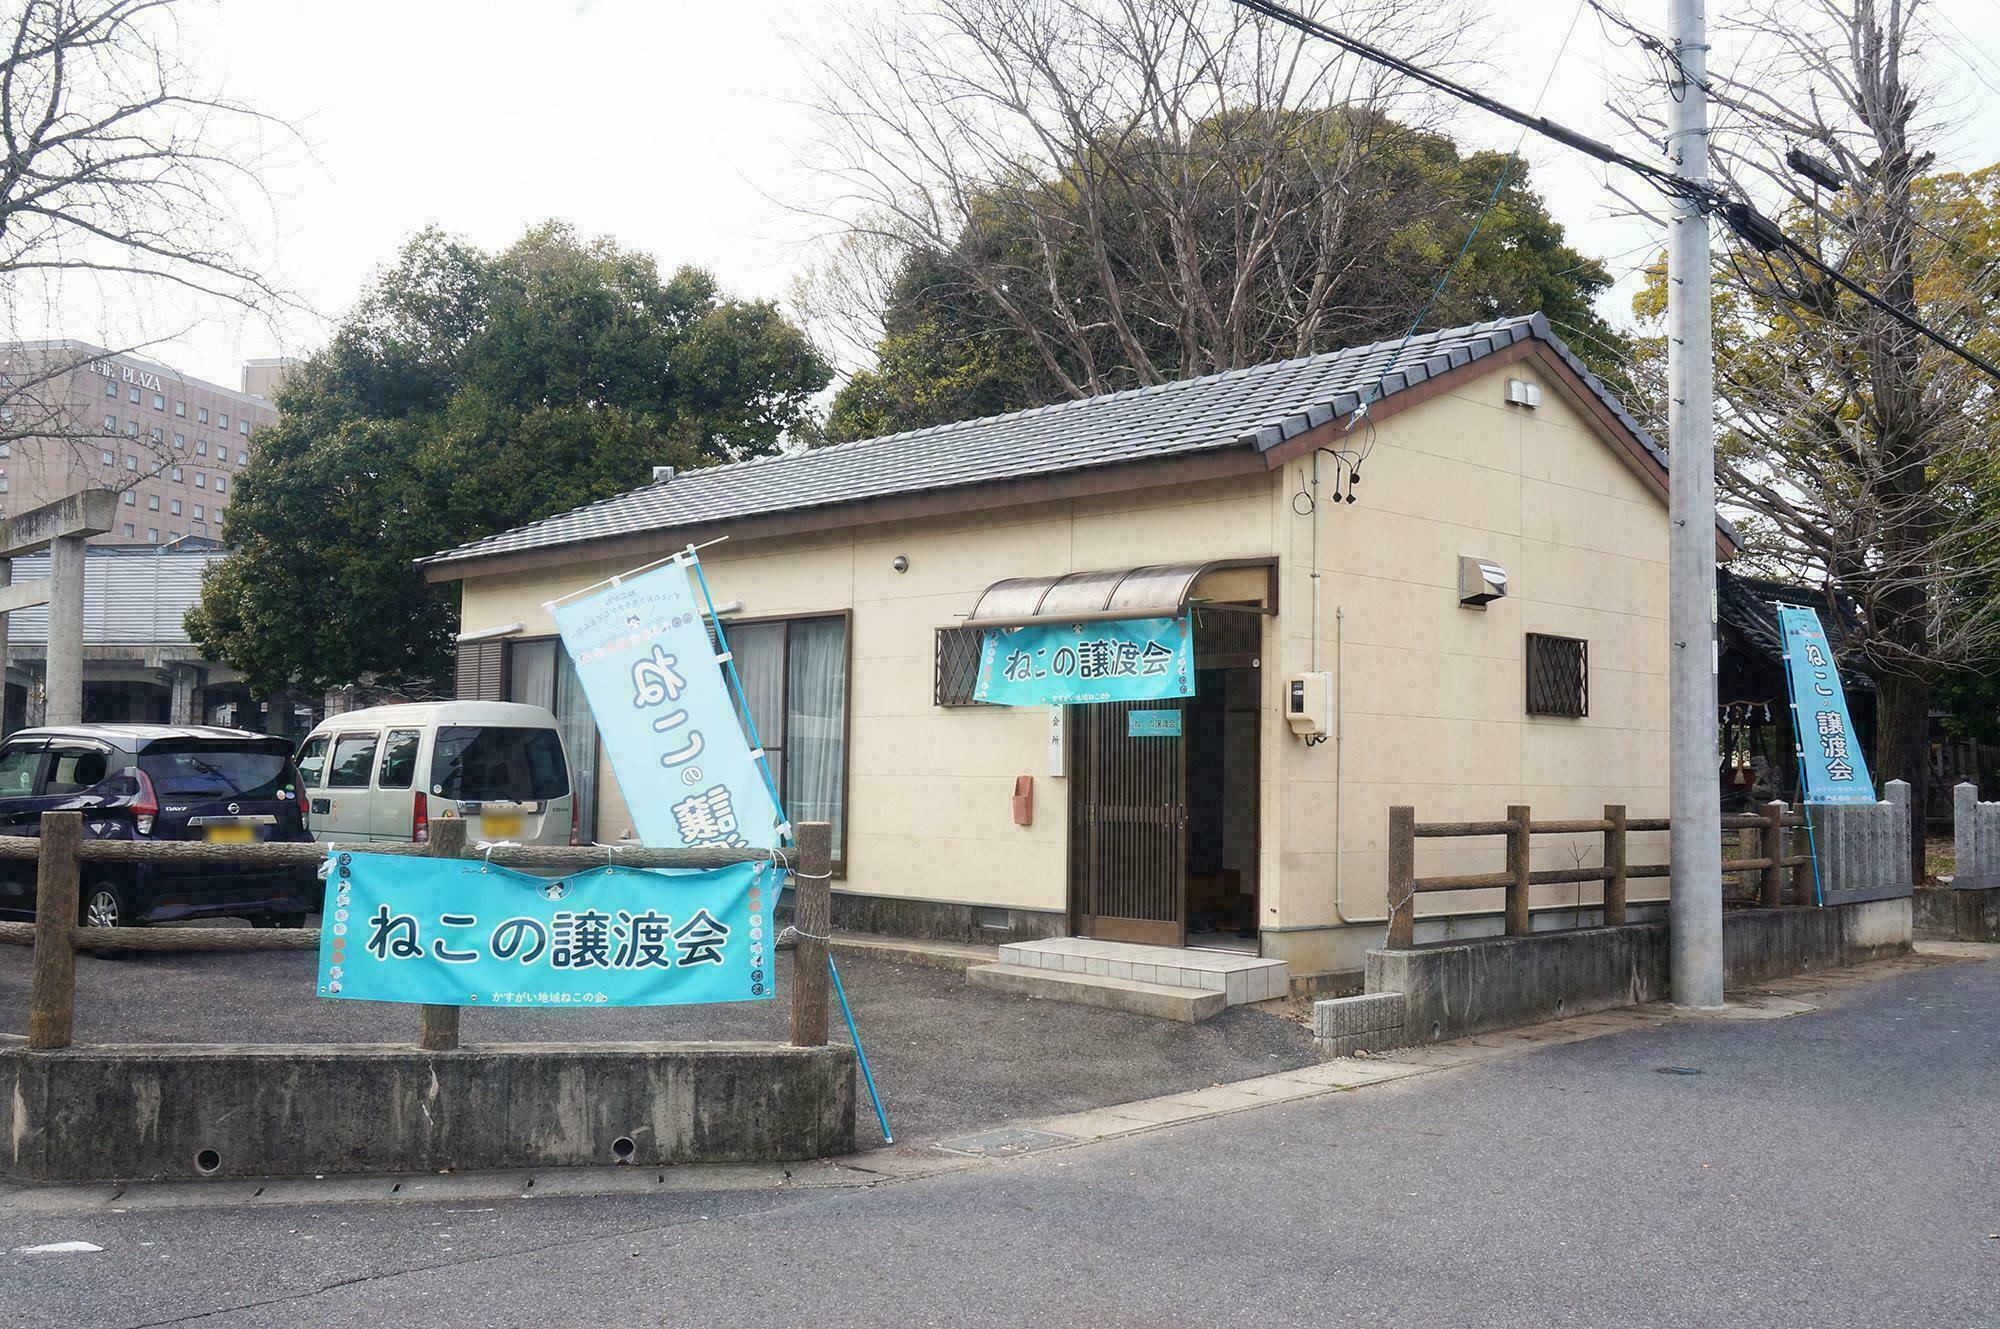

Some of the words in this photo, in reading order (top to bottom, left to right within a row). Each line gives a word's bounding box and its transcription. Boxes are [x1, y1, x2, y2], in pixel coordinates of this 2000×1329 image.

[122, 365, 162, 392] PLAZA
[1004, 637, 1173, 682] ねこの譲渡会
[1806, 641, 1854, 781] ねこの譲渡会
[366, 902, 733, 970] ねこの譲渡会
[492, 991, 607, 1004] かすがい地域ねこの会
